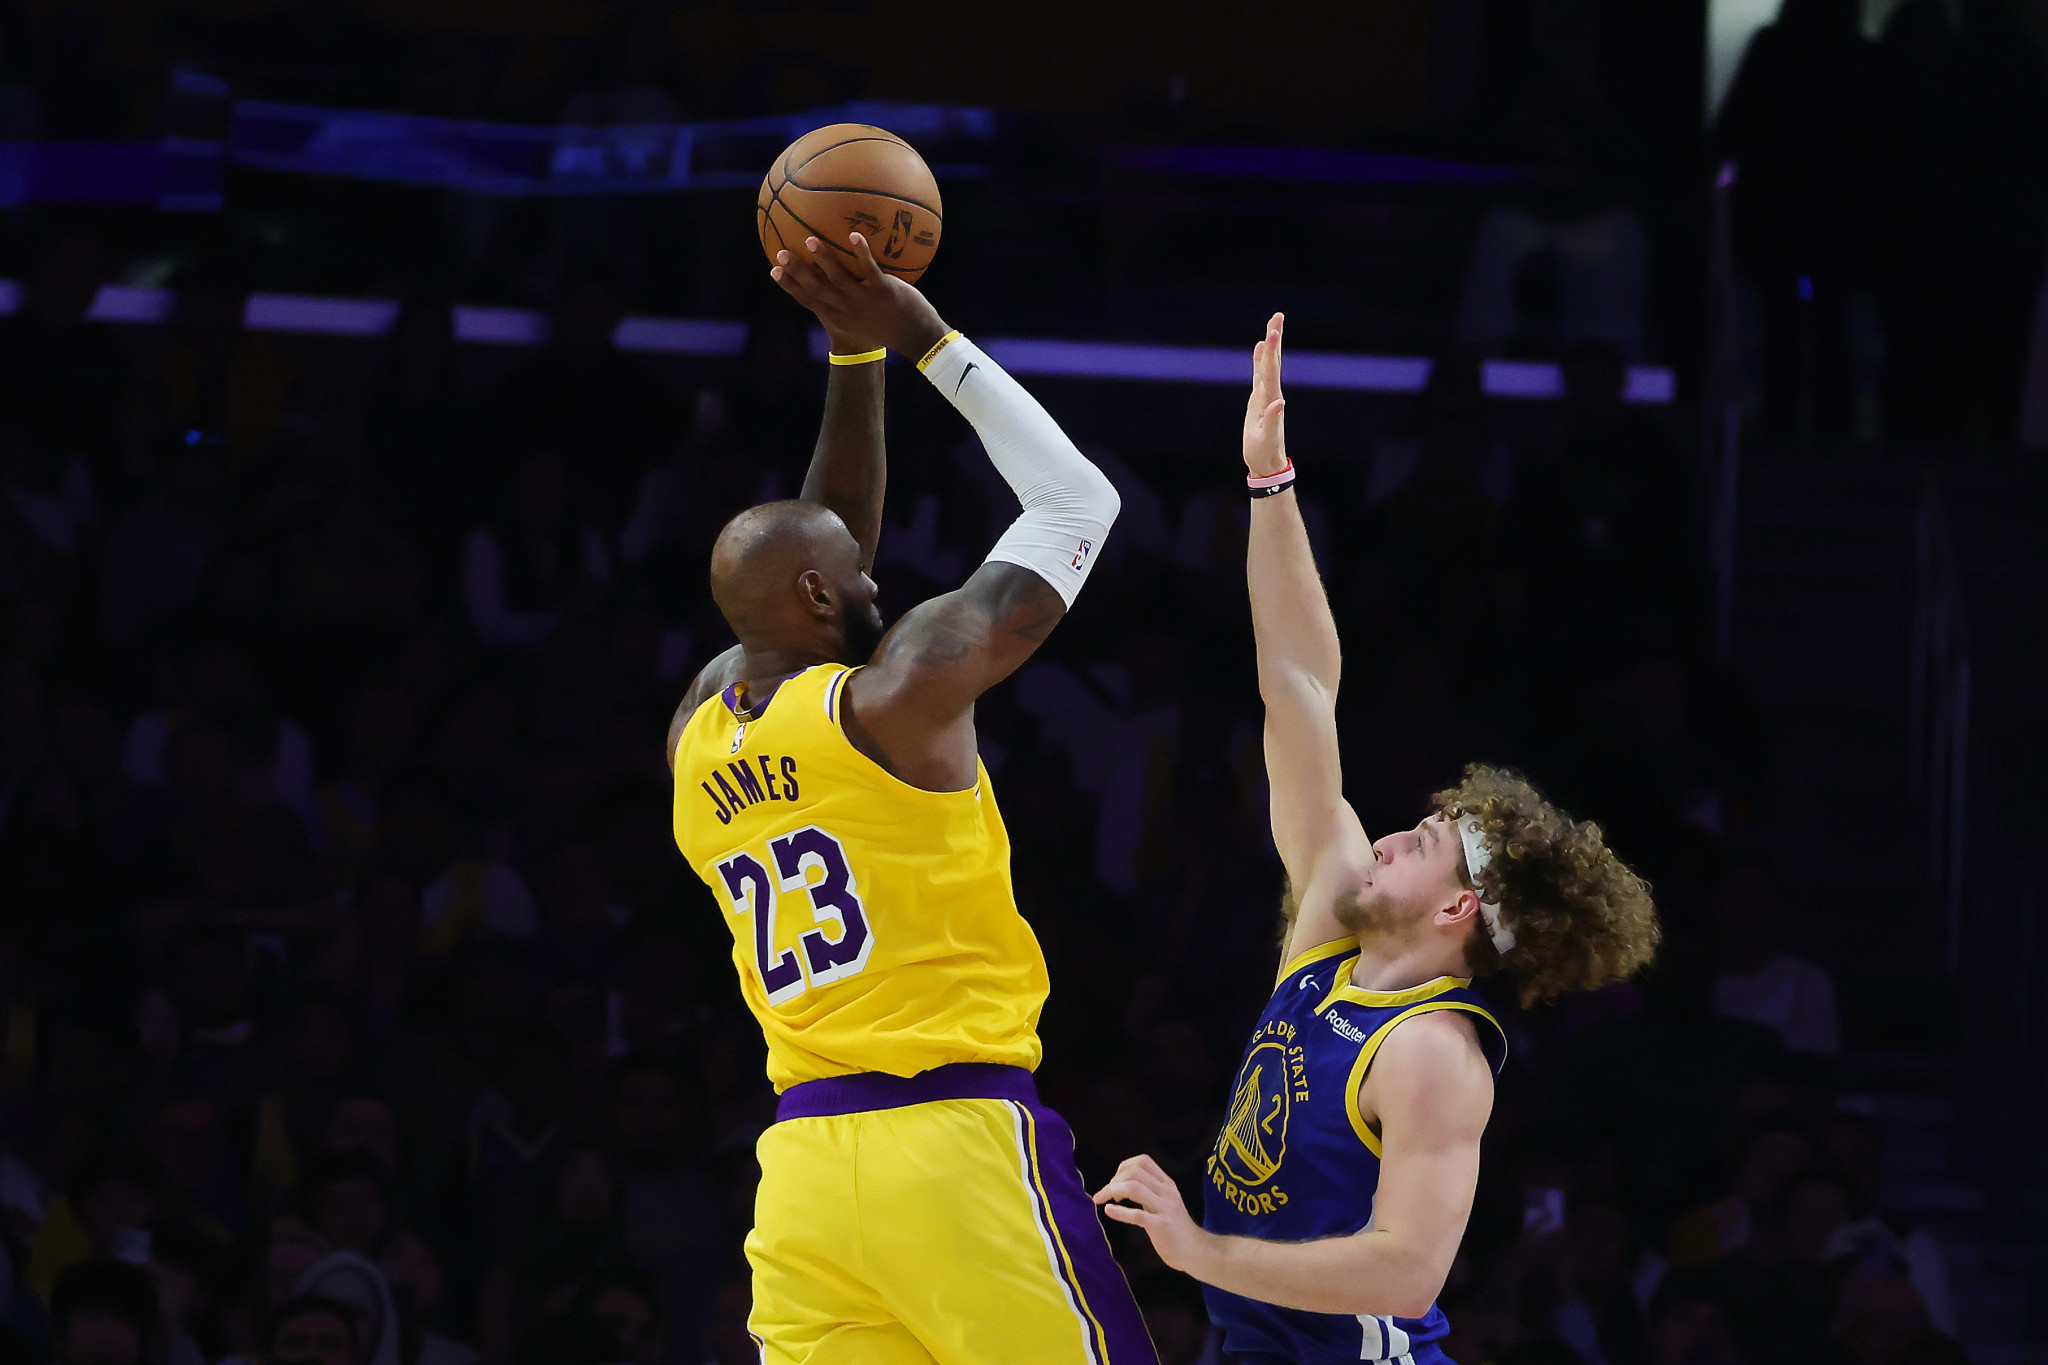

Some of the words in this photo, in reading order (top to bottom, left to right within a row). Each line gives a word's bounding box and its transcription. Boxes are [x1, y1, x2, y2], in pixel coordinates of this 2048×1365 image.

[701, 755, 800, 825] JAMES
[714, 824, 875, 1007] 23
[1325, 1008, 1366, 1044] Rakuten
[1288, 1046, 1309, 1102] STATE
[1261, 1093, 1282, 1135] 2
[1207, 1153, 1289, 1216] ARRIORS
